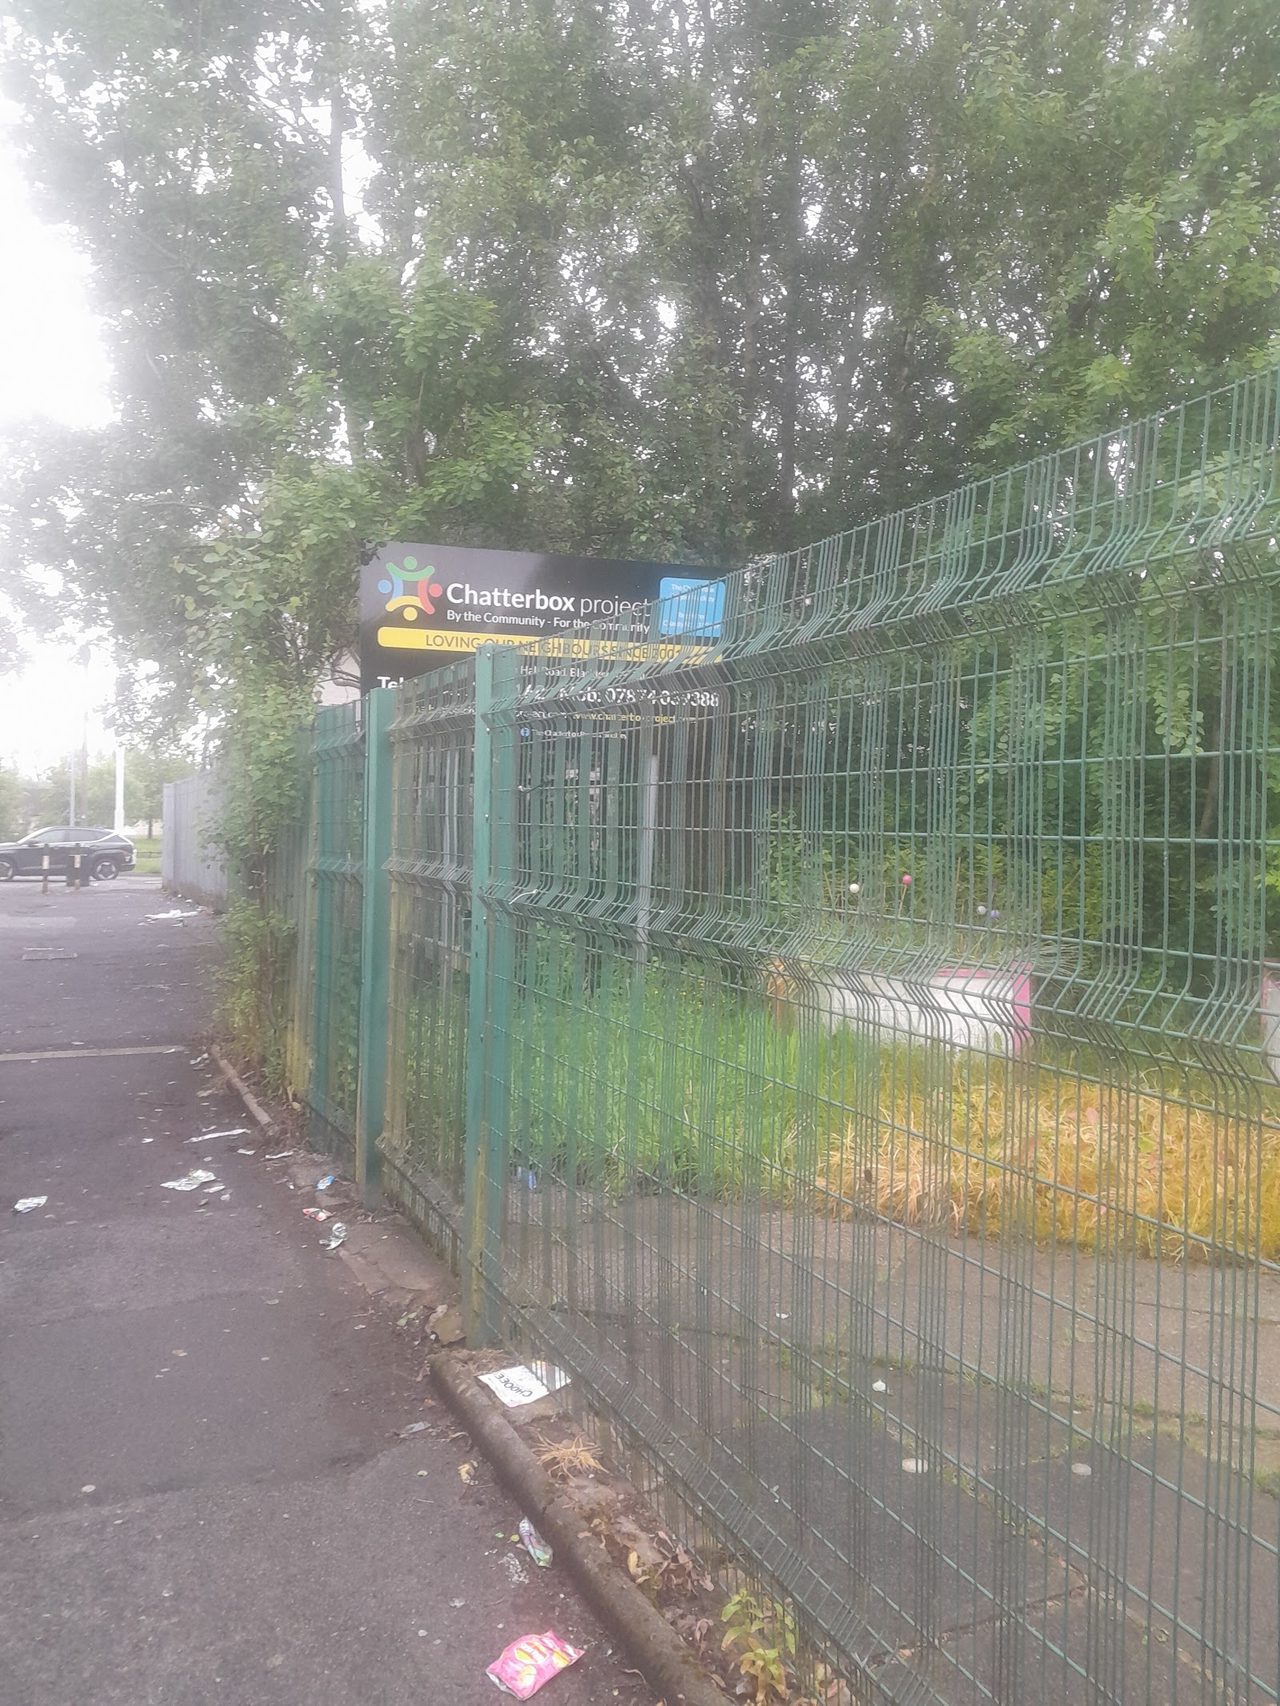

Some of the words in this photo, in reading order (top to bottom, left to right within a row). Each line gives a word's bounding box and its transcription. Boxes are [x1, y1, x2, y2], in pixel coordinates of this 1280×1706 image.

[446, 583, 575, 612] Chatterbox
[580, 595, 651, 618] project
[447, 609, 461, 623] By
[463, 611, 482, 622] the
[484, 612, 546, 628] Community
[554, 617, 571, 628] For
[426, 634, 480, 650] LOVING
